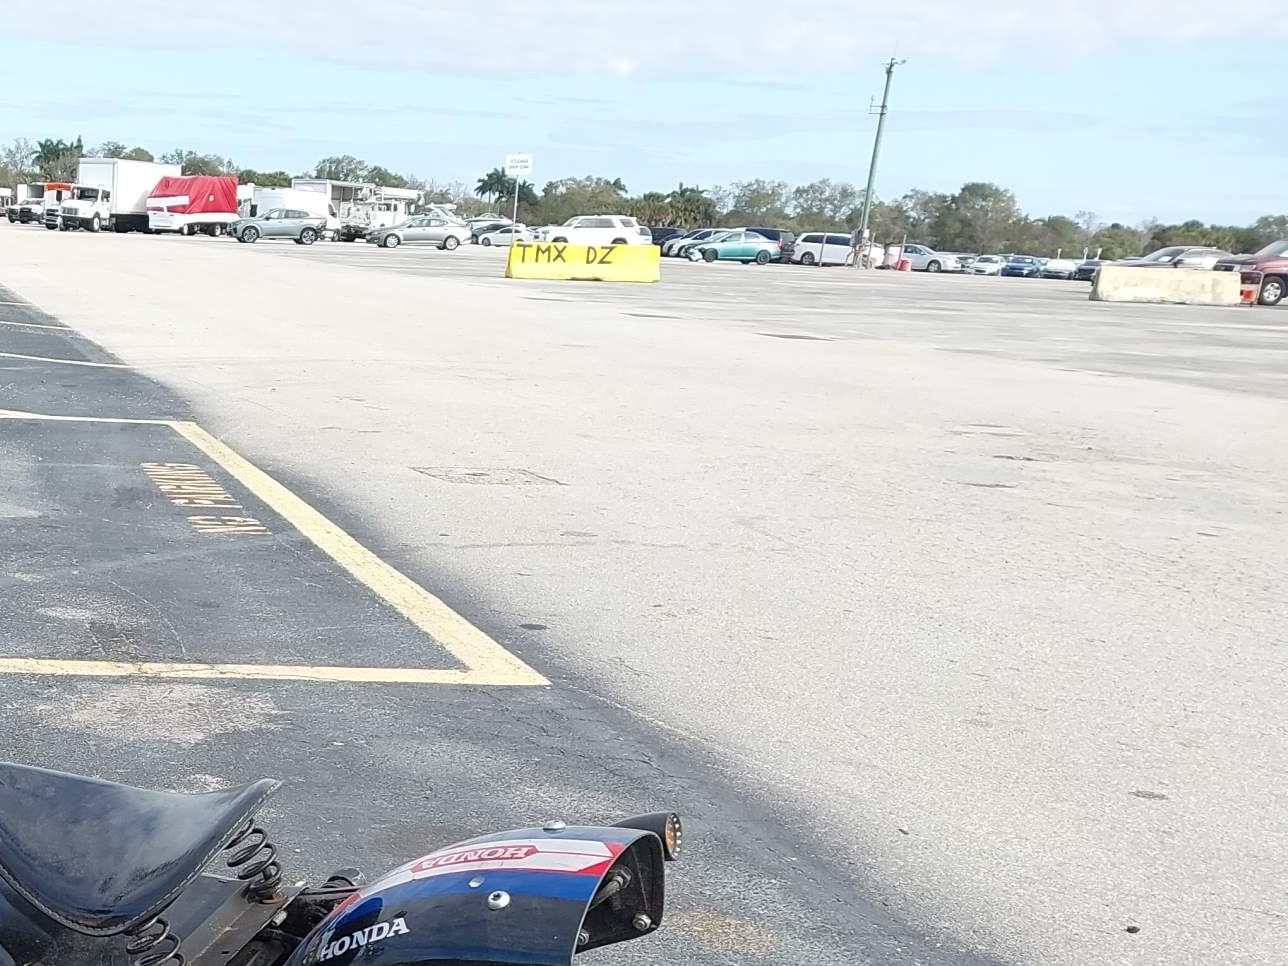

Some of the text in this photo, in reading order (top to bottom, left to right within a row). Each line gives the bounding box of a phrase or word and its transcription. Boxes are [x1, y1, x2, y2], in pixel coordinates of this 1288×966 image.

[516, 243, 618, 265] TMX DZ
[421, 846, 534, 869] HONDA
[318, 916, 411, 962] HONDA
